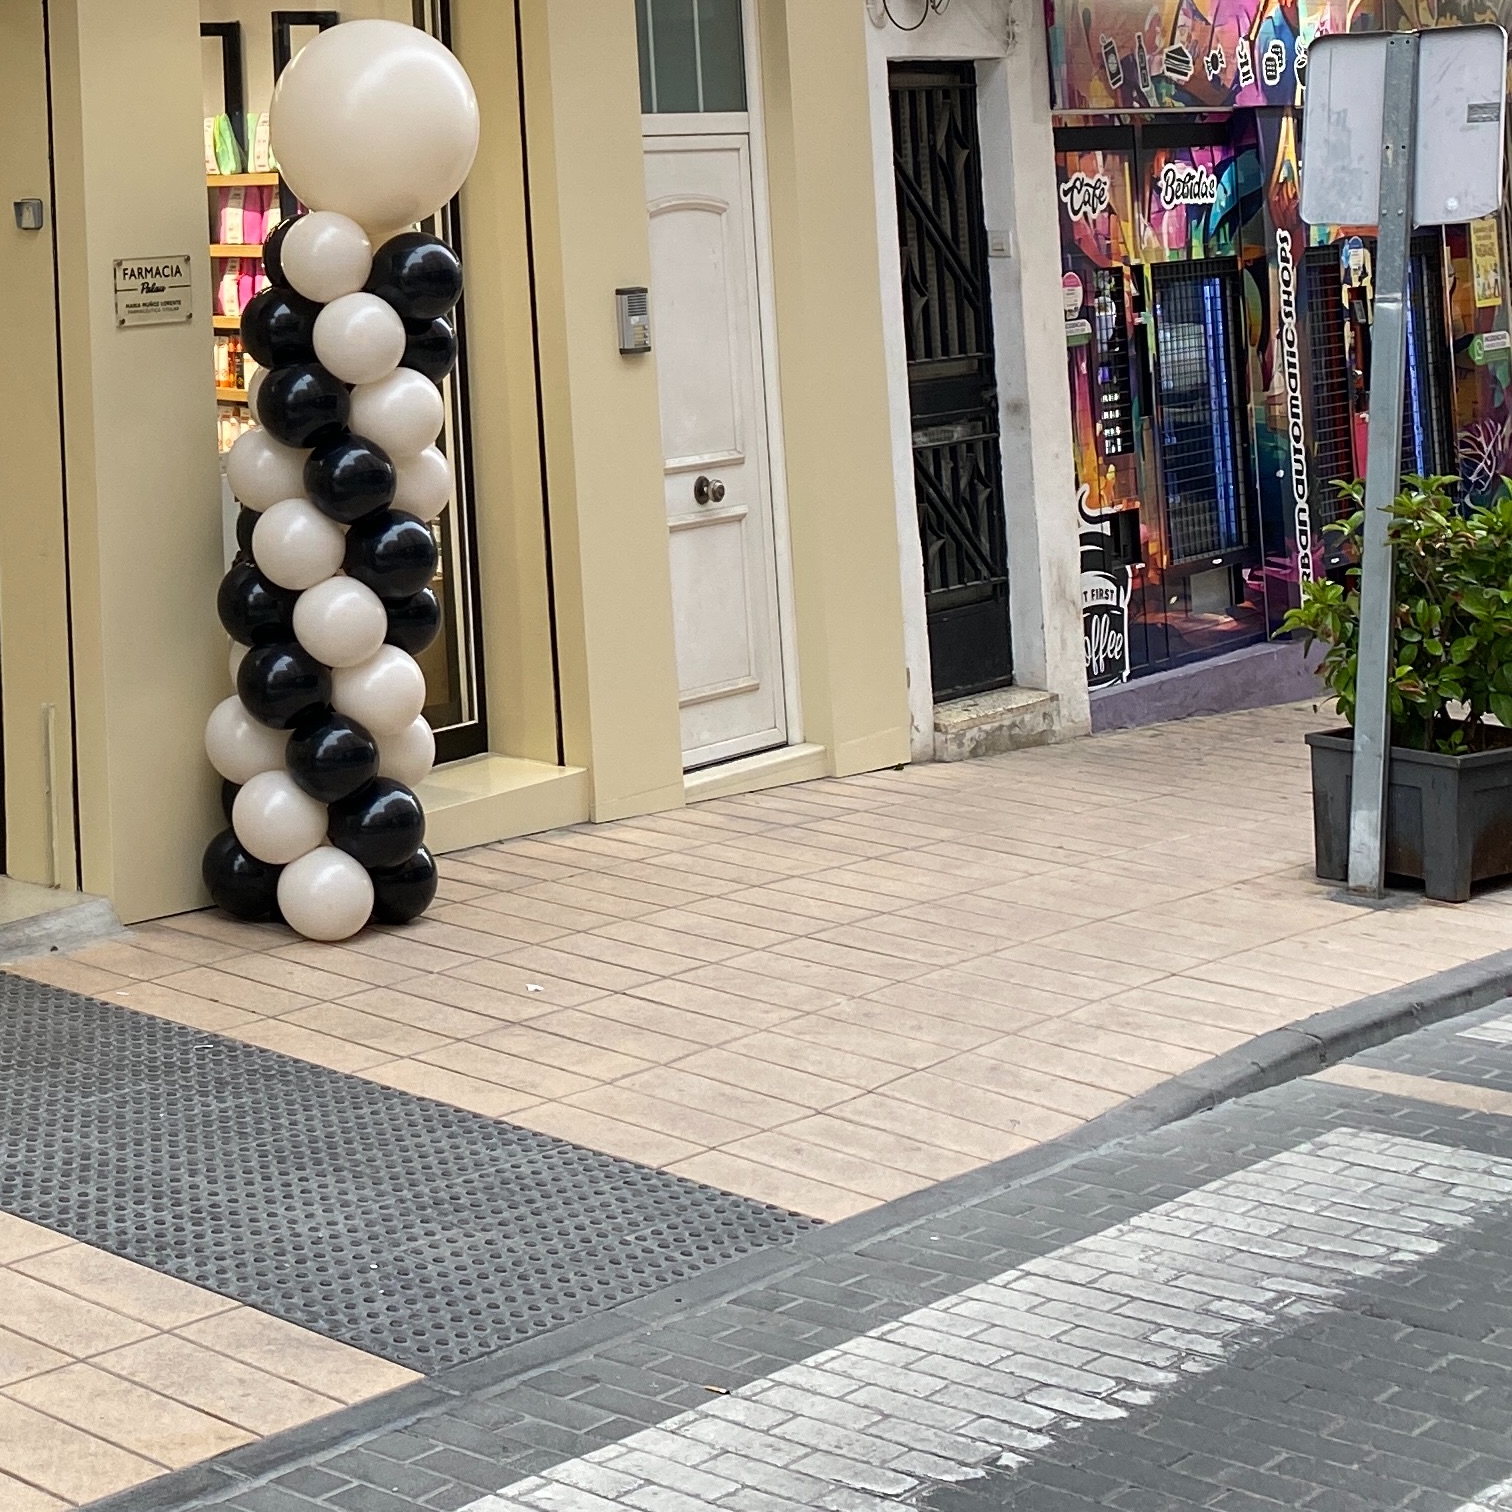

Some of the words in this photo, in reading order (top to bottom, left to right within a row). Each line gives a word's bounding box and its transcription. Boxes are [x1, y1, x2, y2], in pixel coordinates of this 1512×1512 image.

[1062, 177, 1108, 216] Café
[1163, 168, 1215, 204] Bebidas
[122, 265, 183, 280] FARMACIA
[1091, 588, 1115, 601] FIRST
[1084, 614, 1124, 676] offee
